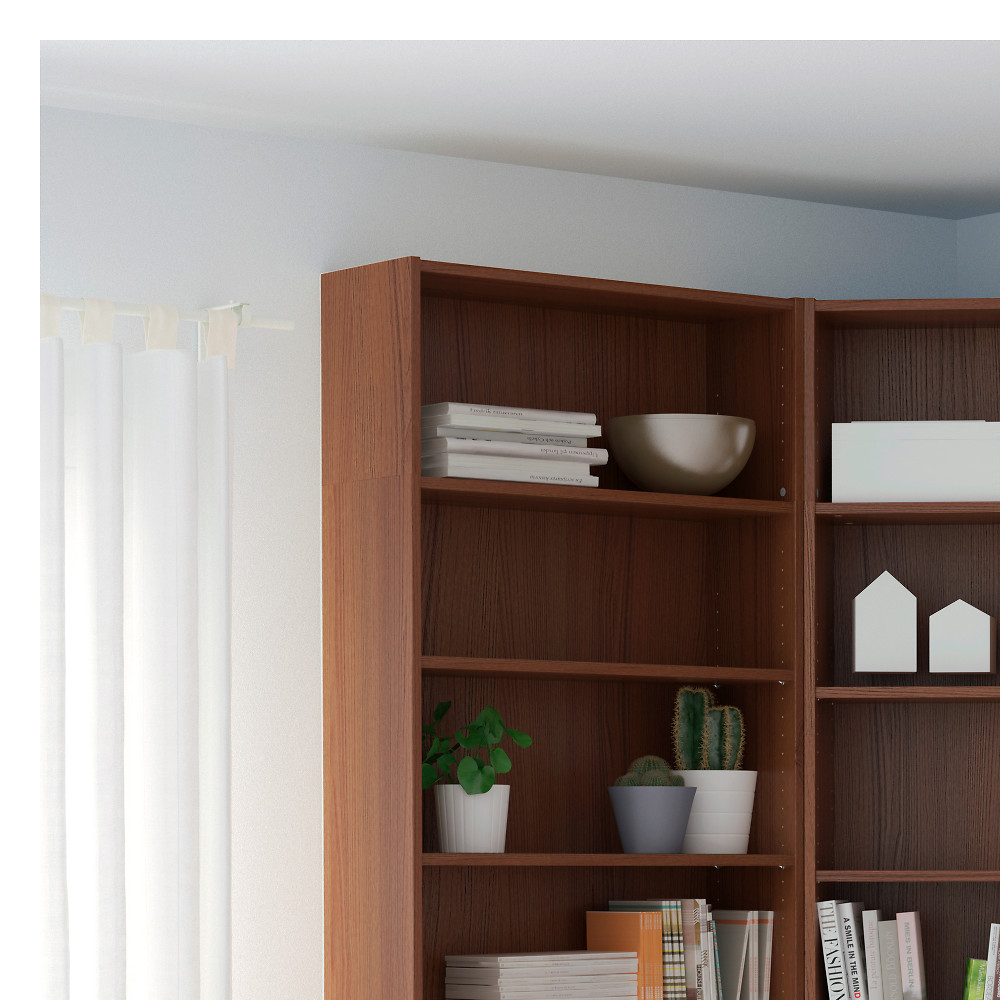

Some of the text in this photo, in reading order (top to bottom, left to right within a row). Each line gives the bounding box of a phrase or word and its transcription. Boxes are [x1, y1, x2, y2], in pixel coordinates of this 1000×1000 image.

[820, 901, 834, 936] THE
[844, 925, 854, 949] SMILE
[848, 950, 855, 960] IN
[904, 922, 916, 989] MIES IN BERLIN
[850, 961, 858, 976] THE
[853, 977, 861, 999] MIND
